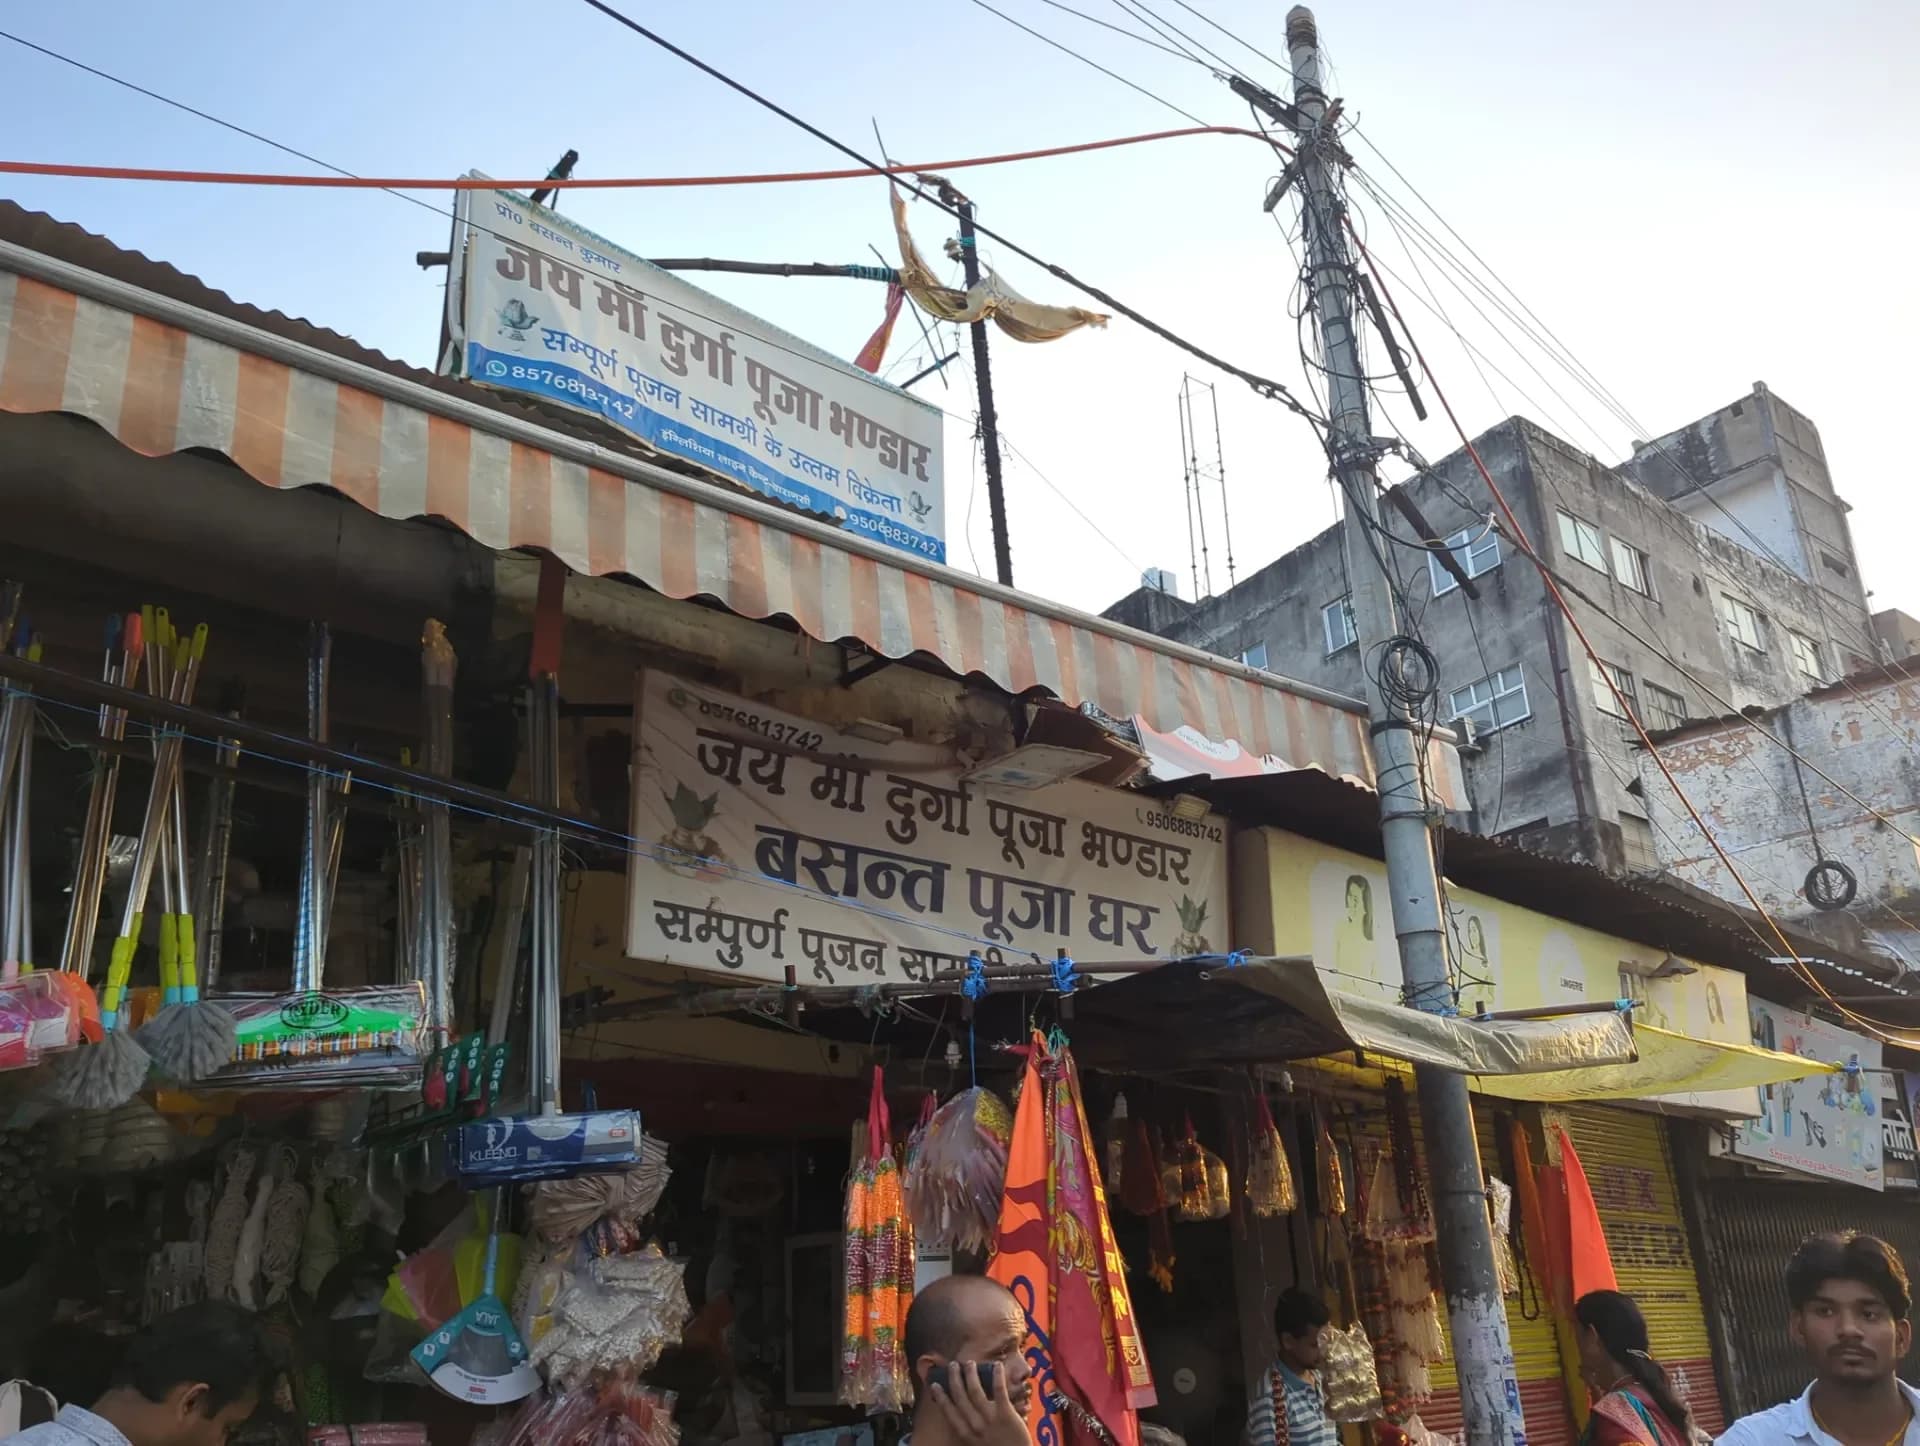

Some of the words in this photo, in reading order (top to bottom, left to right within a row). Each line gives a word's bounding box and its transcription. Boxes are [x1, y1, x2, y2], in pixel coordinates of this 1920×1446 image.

[579, 245, 622, 274] कुमार
[493, 233, 584, 311] जय
[657, 311, 736, 386] दुर्गा
[744, 356, 823, 431] पूजा
[829, 400, 931, 482] भण्डार
[511, 366, 633, 420] 8576813742
[541, 327, 618, 379] सम्पूर्ण
[625, 365, 681, 409] पूजन
[688, 396, 758, 447] सामग्री
[763, 427, 783, 458] के
[788, 447, 840, 488] उत्तम
[846, 468, 902, 513] विक्रेता
[849, 513, 937, 556] 9506883742
[696, 728, 793, 796] जय
[986, 799, 1066, 869] पूजा
[1081, 821, 1191, 885] भण्डार
[1146, 810, 1222, 844] 9506883742
[755, 824, 951, 914] बसन्त
[966, 868, 1076, 944] पूजा
[1088, 893, 1160, 955] घर
[653, 899, 790, 969] सम्पुर्ण
[798, 927, 887, 985] पूजन
